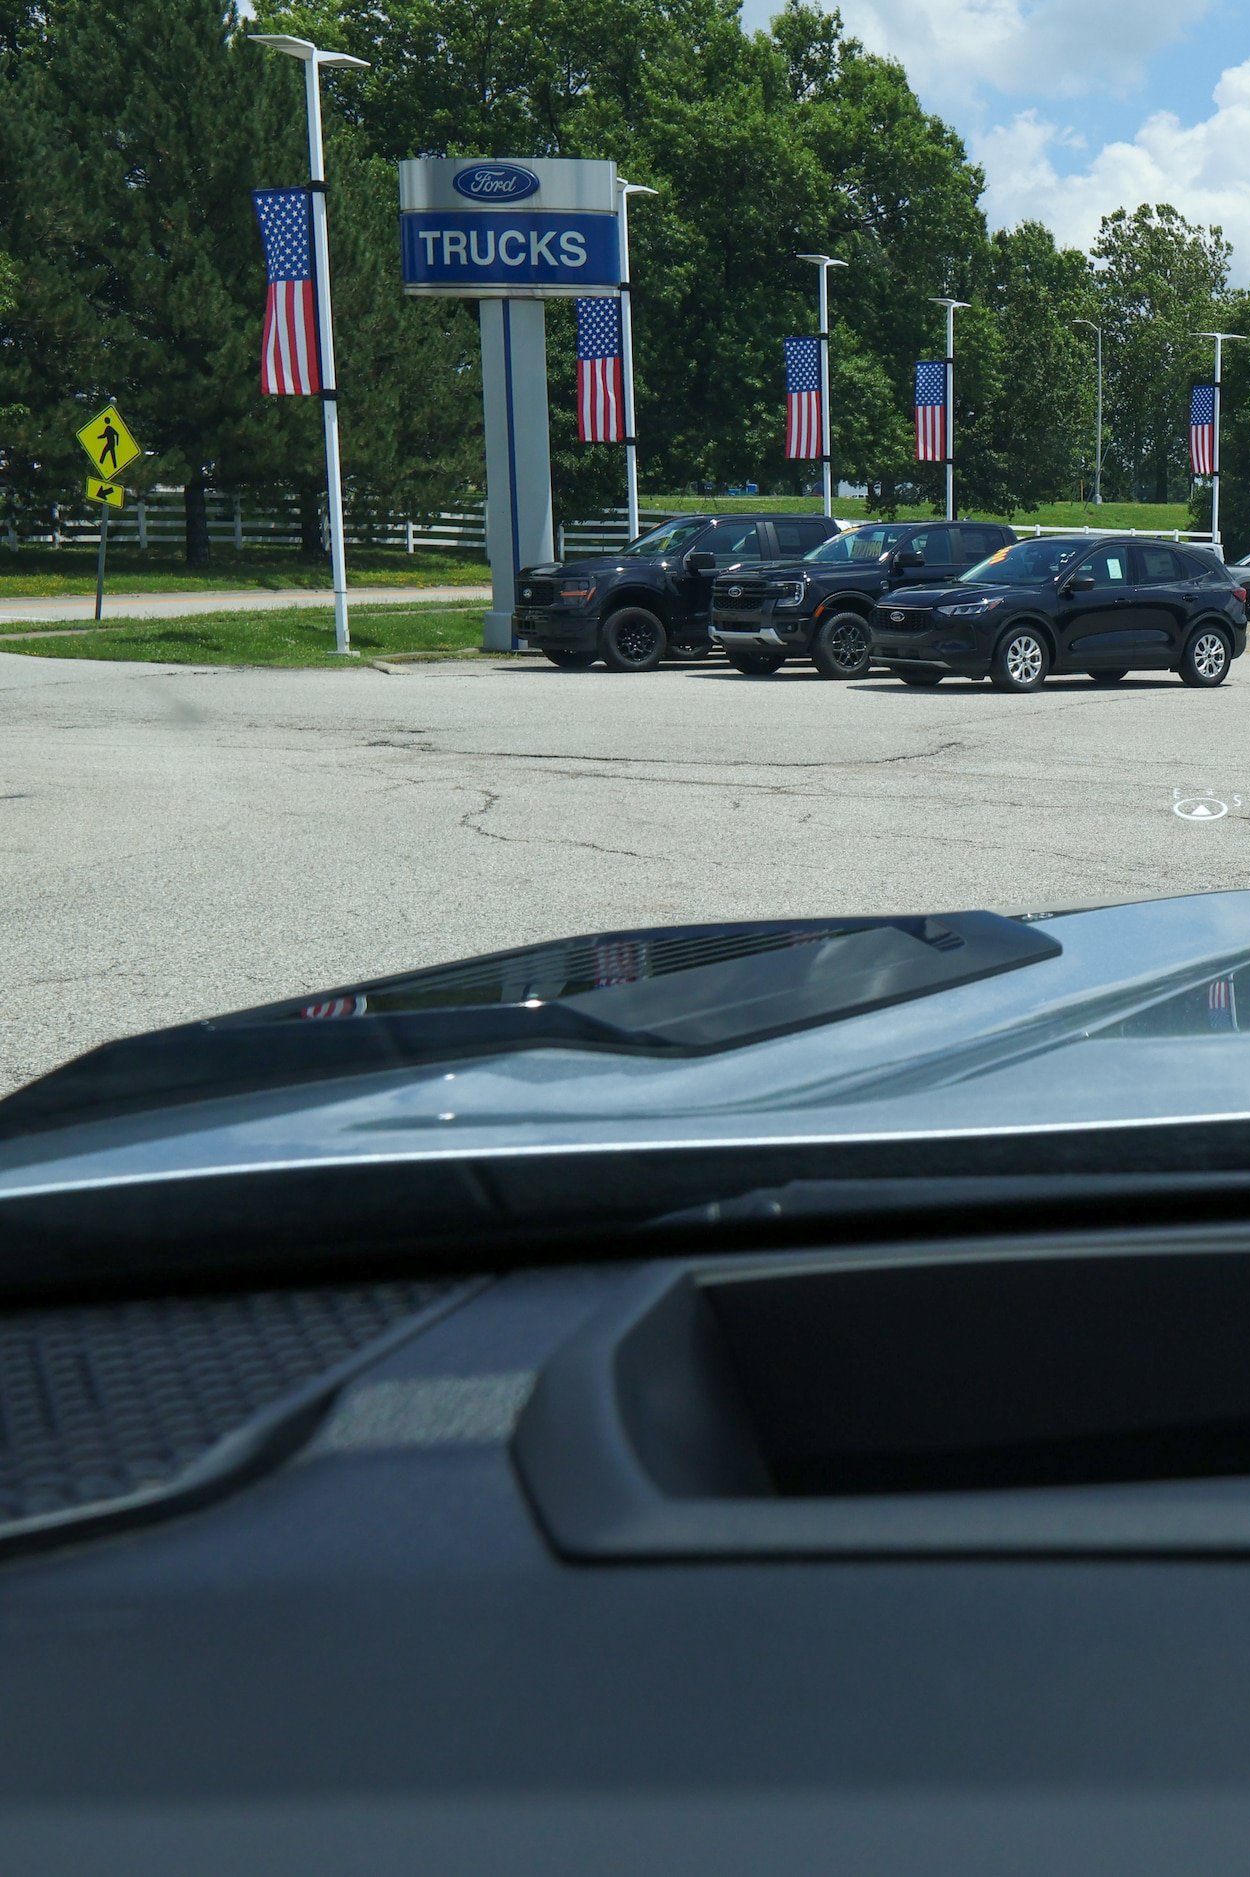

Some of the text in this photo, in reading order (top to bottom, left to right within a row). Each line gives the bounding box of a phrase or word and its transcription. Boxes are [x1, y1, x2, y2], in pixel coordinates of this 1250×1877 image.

[470, 170, 518, 193] Ford
[418, 229, 588, 268] TRUCKS
[1173, 787, 1181, 799] E
